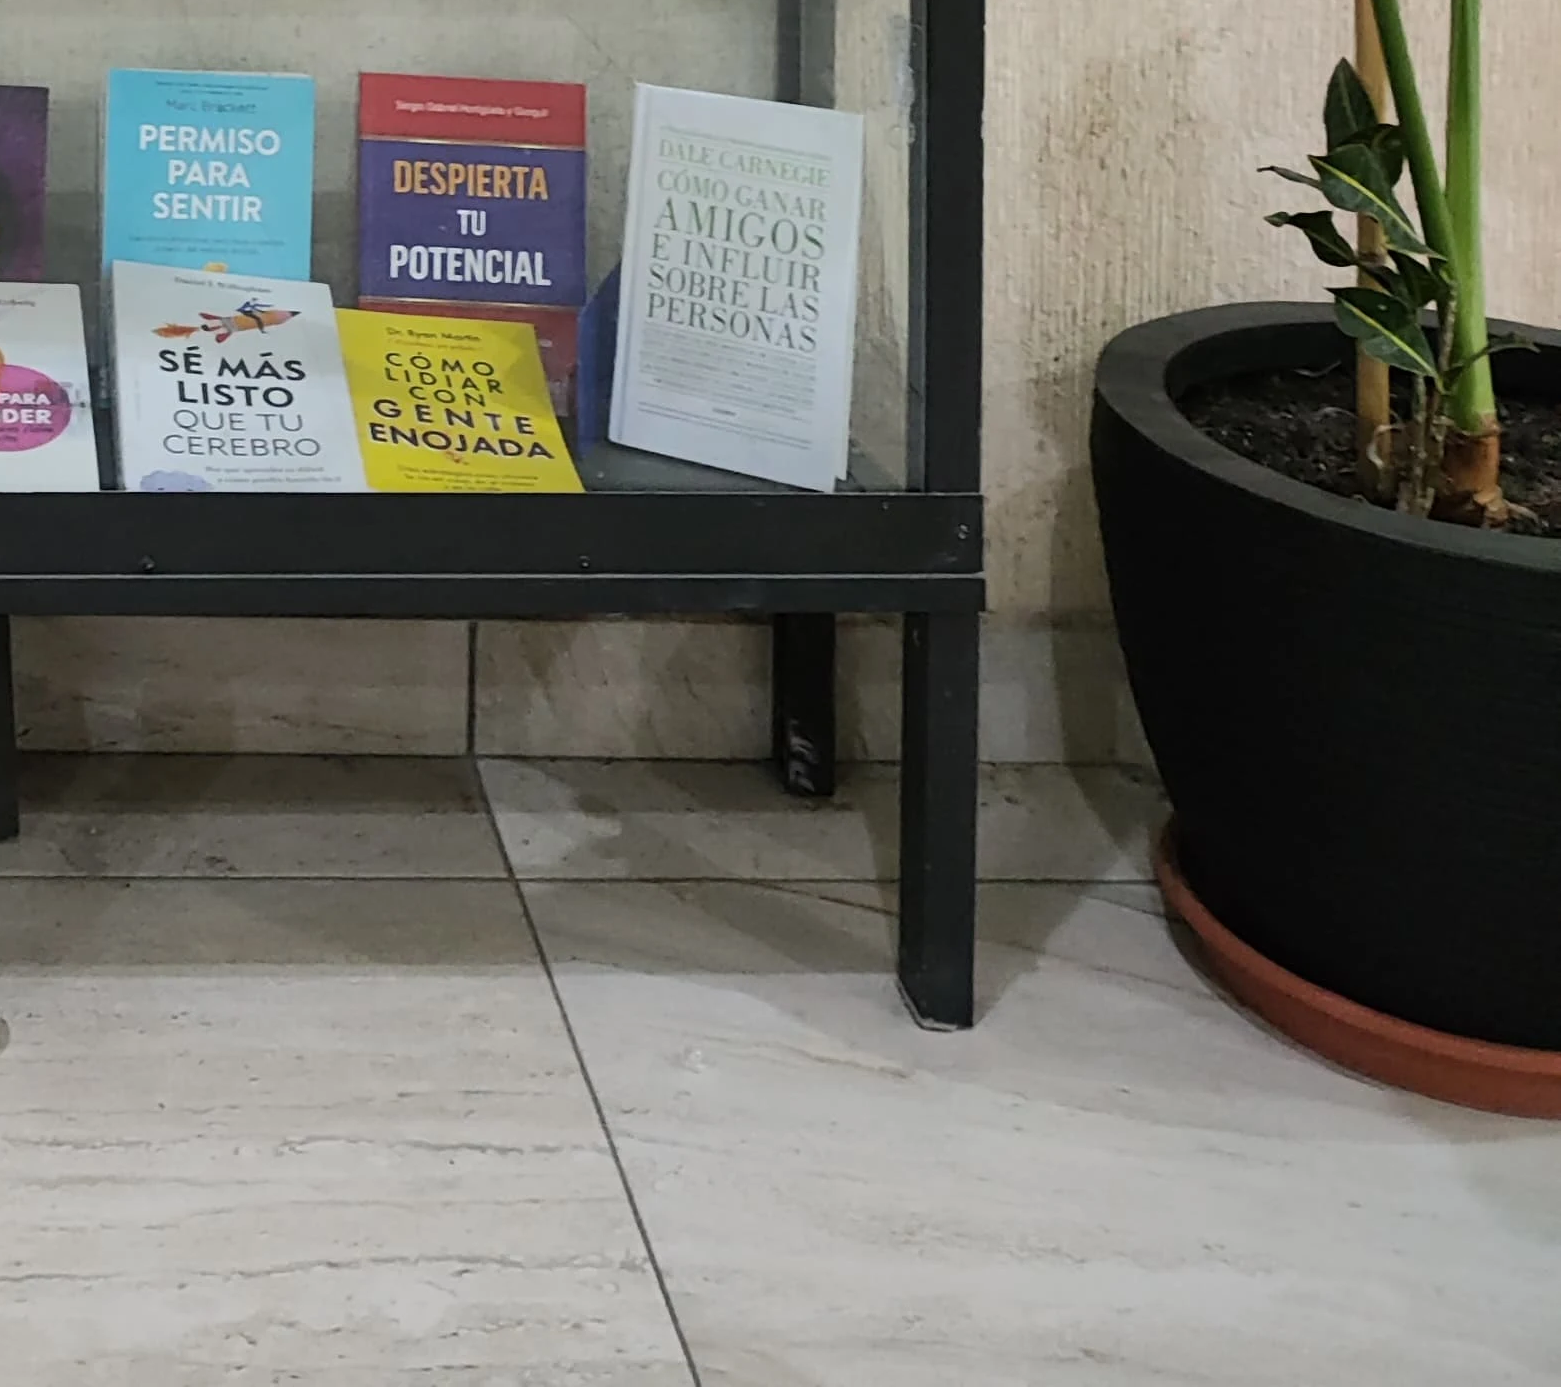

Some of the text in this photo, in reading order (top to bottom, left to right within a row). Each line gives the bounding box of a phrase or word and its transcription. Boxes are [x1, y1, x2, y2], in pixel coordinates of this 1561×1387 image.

[138, 123, 282, 156] PERMISO
[167, 158, 251, 188] PARA
[393, 159, 548, 201] DESPIERTA
[658, 137, 832, 188] DALE CARNEGIE
[152, 191, 263, 223] SENTIR
[656, 167, 828, 223] CÓMO GANAR
[456, 209, 487, 236] TU
[653, 195, 827, 261] AMIGOS
[389, 244, 552, 286] POTENCIAL
[651, 232, 823, 294] E INFLUIR
[646, 262, 821, 324] SOBRE LAS
[645, 291, 818, 354] PERSONAS
[158, 345, 307, 381] SÉ MÁS
[384, 351, 495, 377] CÓMO
[384, 367, 504, 394] LIDIAR
[177, 380, 294, 408] LISTO
[408, 385, 486, 407] CON
[172, 408, 304, 432] QUE TU
[373, 398, 536, 435] GENTE
[162, 433, 321, 457] CEREBRO
[368, 421, 555, 460] ENOJADA
